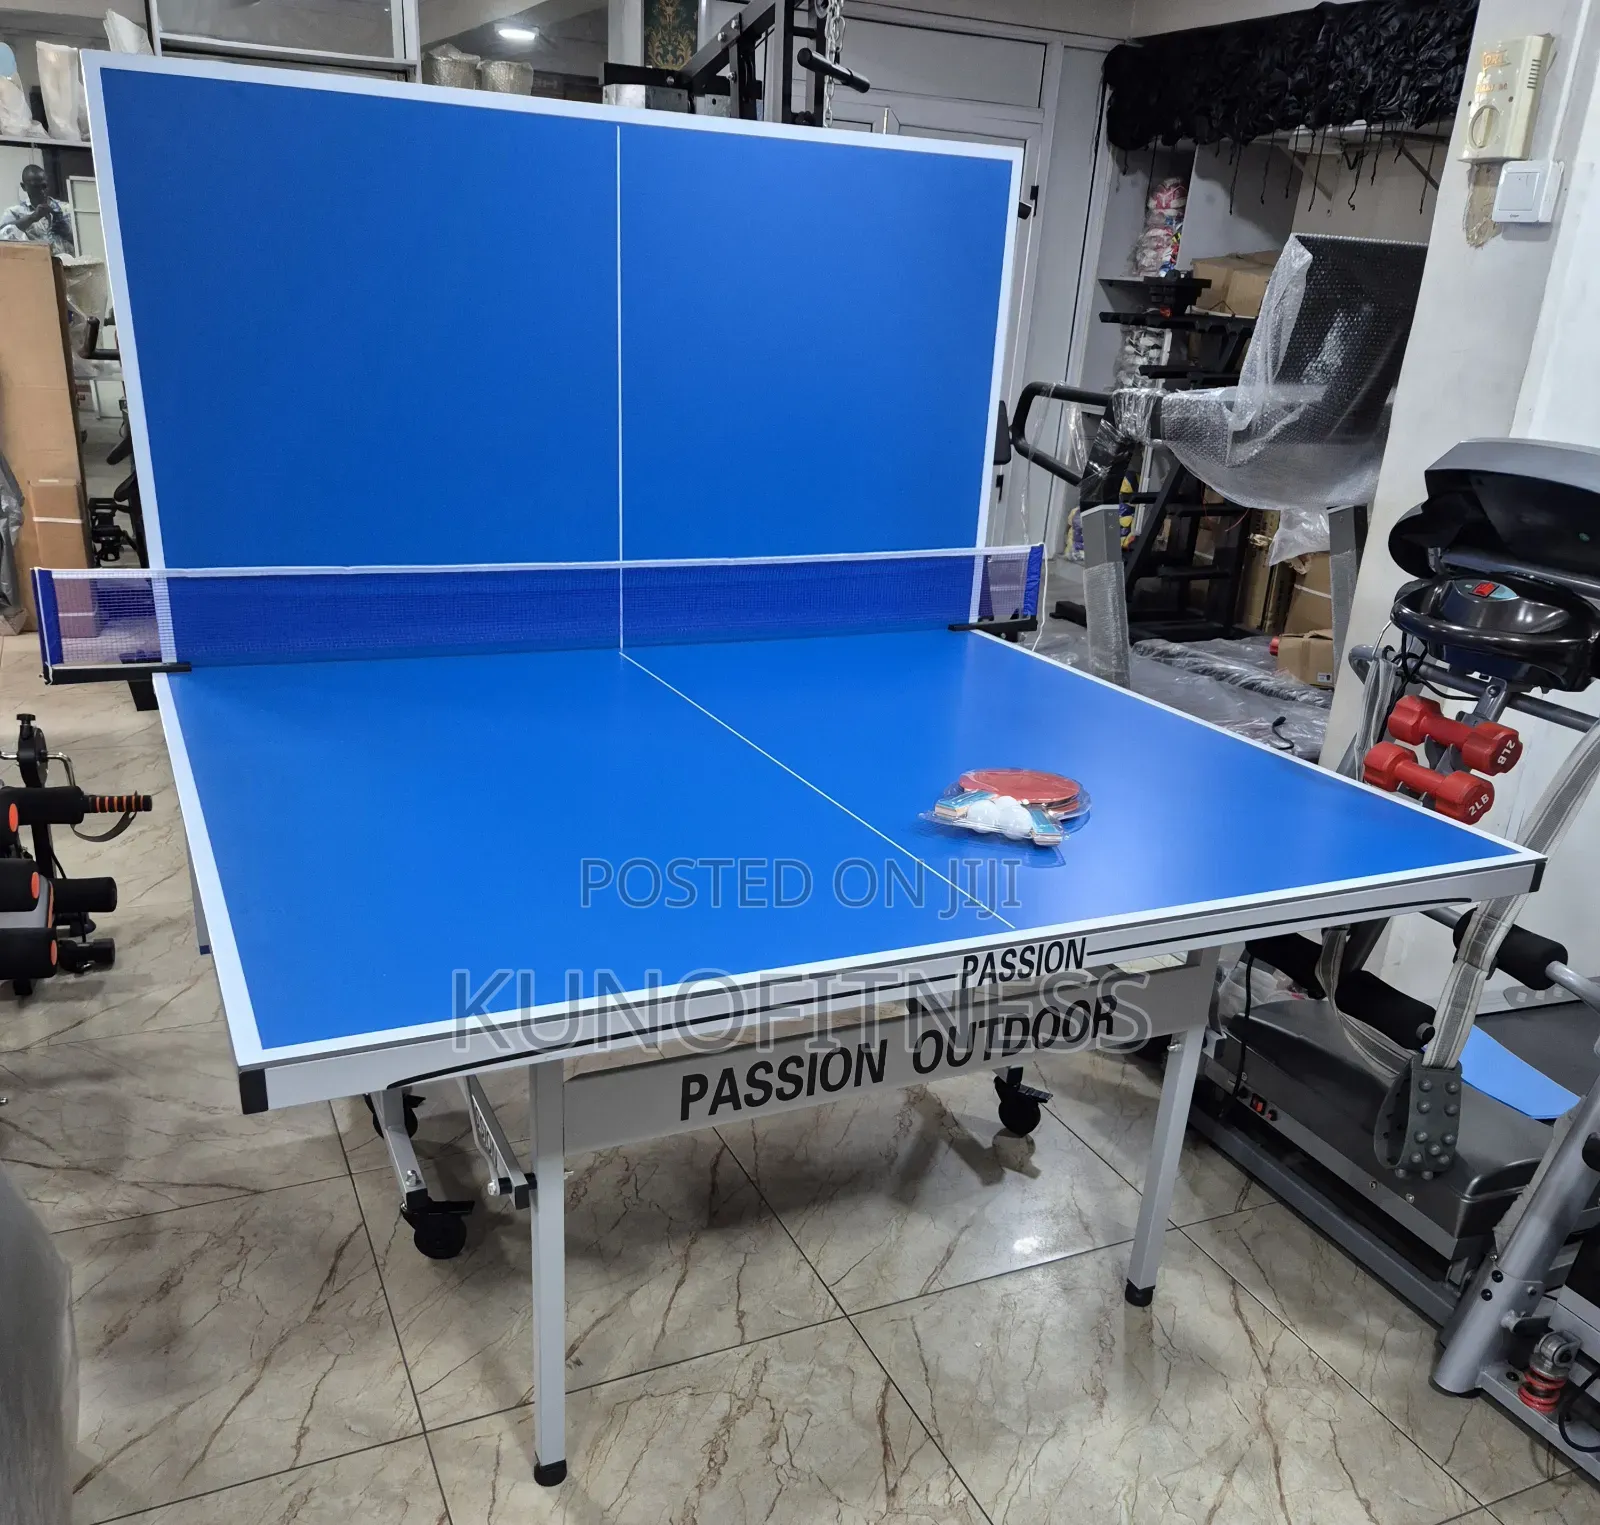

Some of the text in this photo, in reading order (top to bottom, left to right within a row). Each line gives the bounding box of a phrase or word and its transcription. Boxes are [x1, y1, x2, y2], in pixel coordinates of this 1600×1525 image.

[1497, 739, 1516, 765] 2LB
[1468, 793, 1490, 816] 2LB
[962, 937, 1087, 988] PASSION
[680, 995, 1118, 1121] PASSION OUTDOOR
